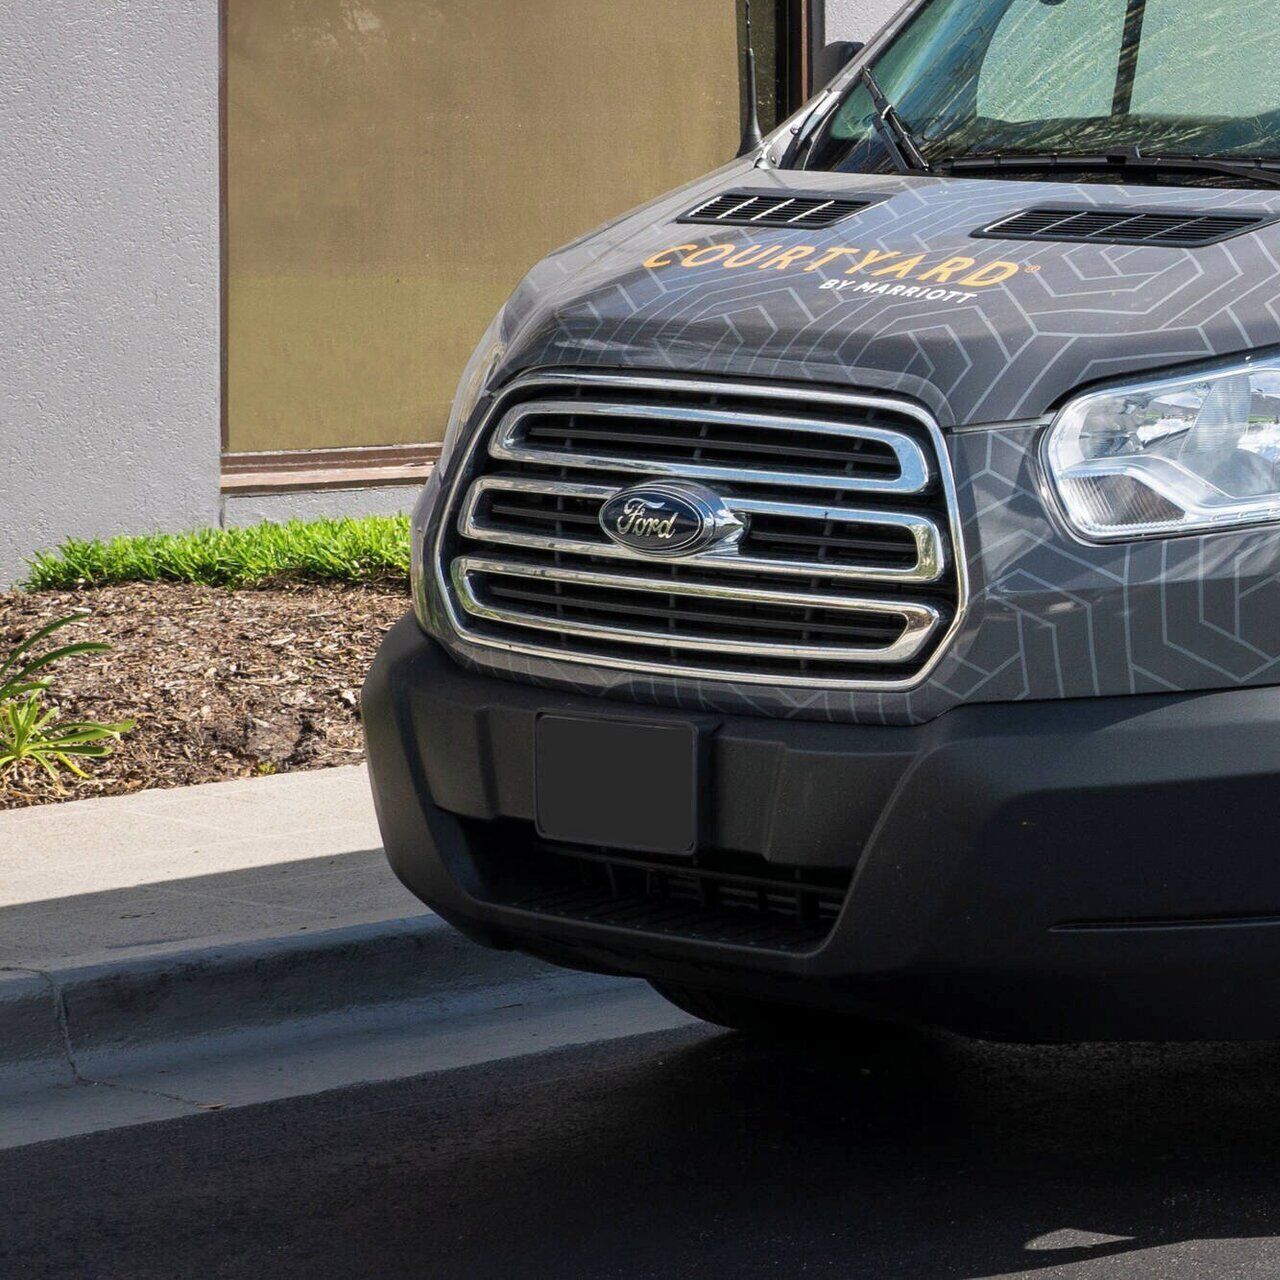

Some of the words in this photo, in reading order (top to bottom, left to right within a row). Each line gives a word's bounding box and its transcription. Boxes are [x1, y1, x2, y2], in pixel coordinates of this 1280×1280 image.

[818, 278, 855, 291] BY
[854, 280, 978, 304] MARRIOTT
[616, 498, 679, 539] Ford
